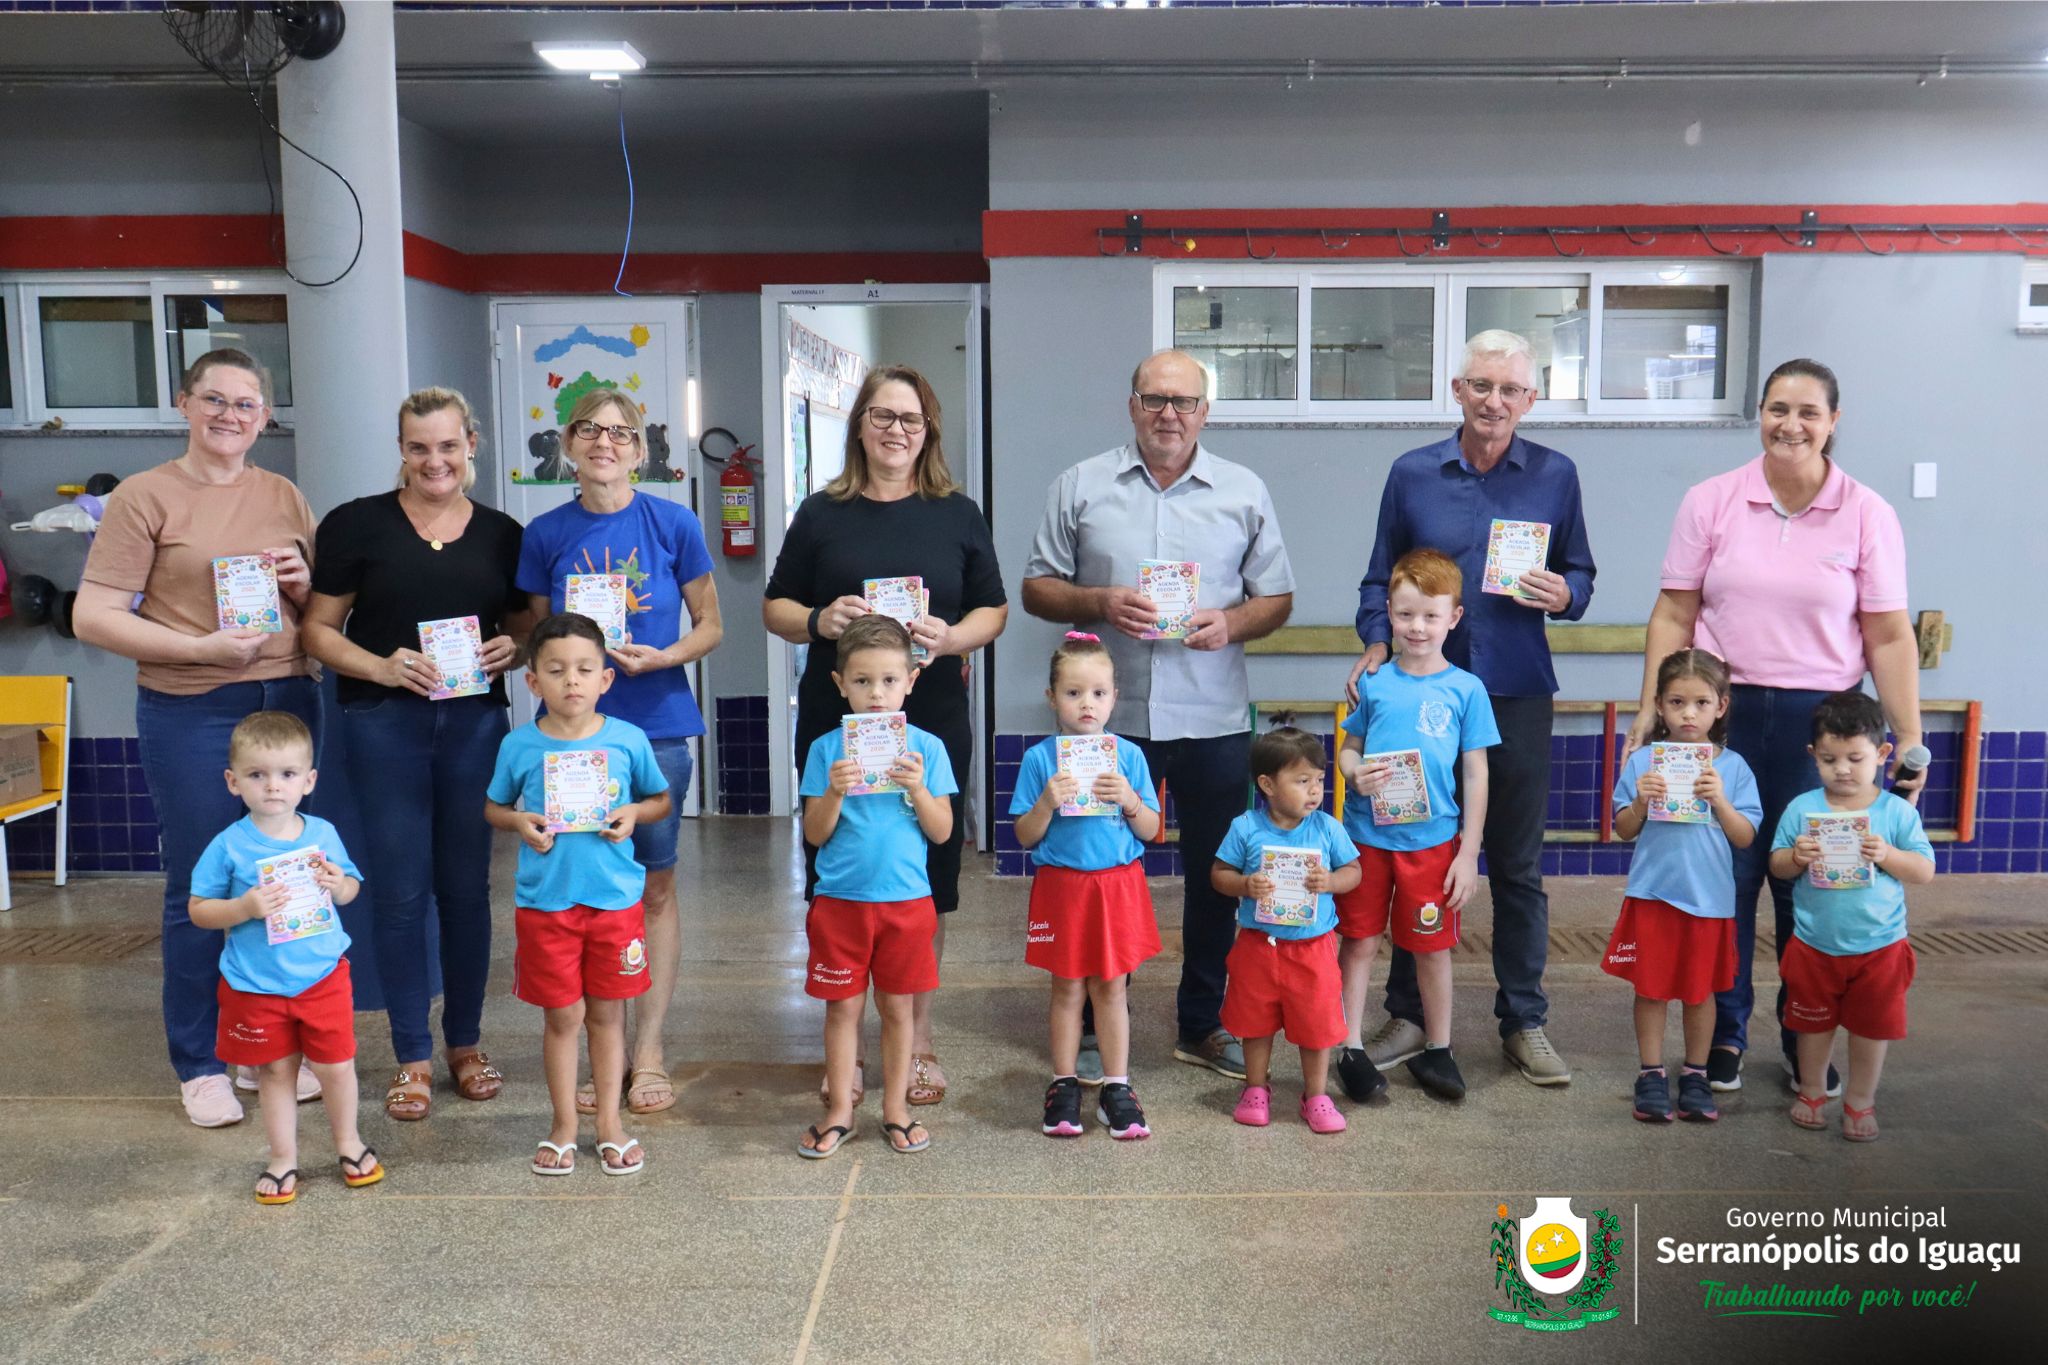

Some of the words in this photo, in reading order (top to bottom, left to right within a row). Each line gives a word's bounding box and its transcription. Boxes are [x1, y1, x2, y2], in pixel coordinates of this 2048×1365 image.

[867, 289, 880, 298] A1
[1029, 921, 1049, 931] Escola
[1616, 942, 1637, 952] Escol
[814, 963, 852, 976] Educação
[812, 973, 853, 985] Municipal
